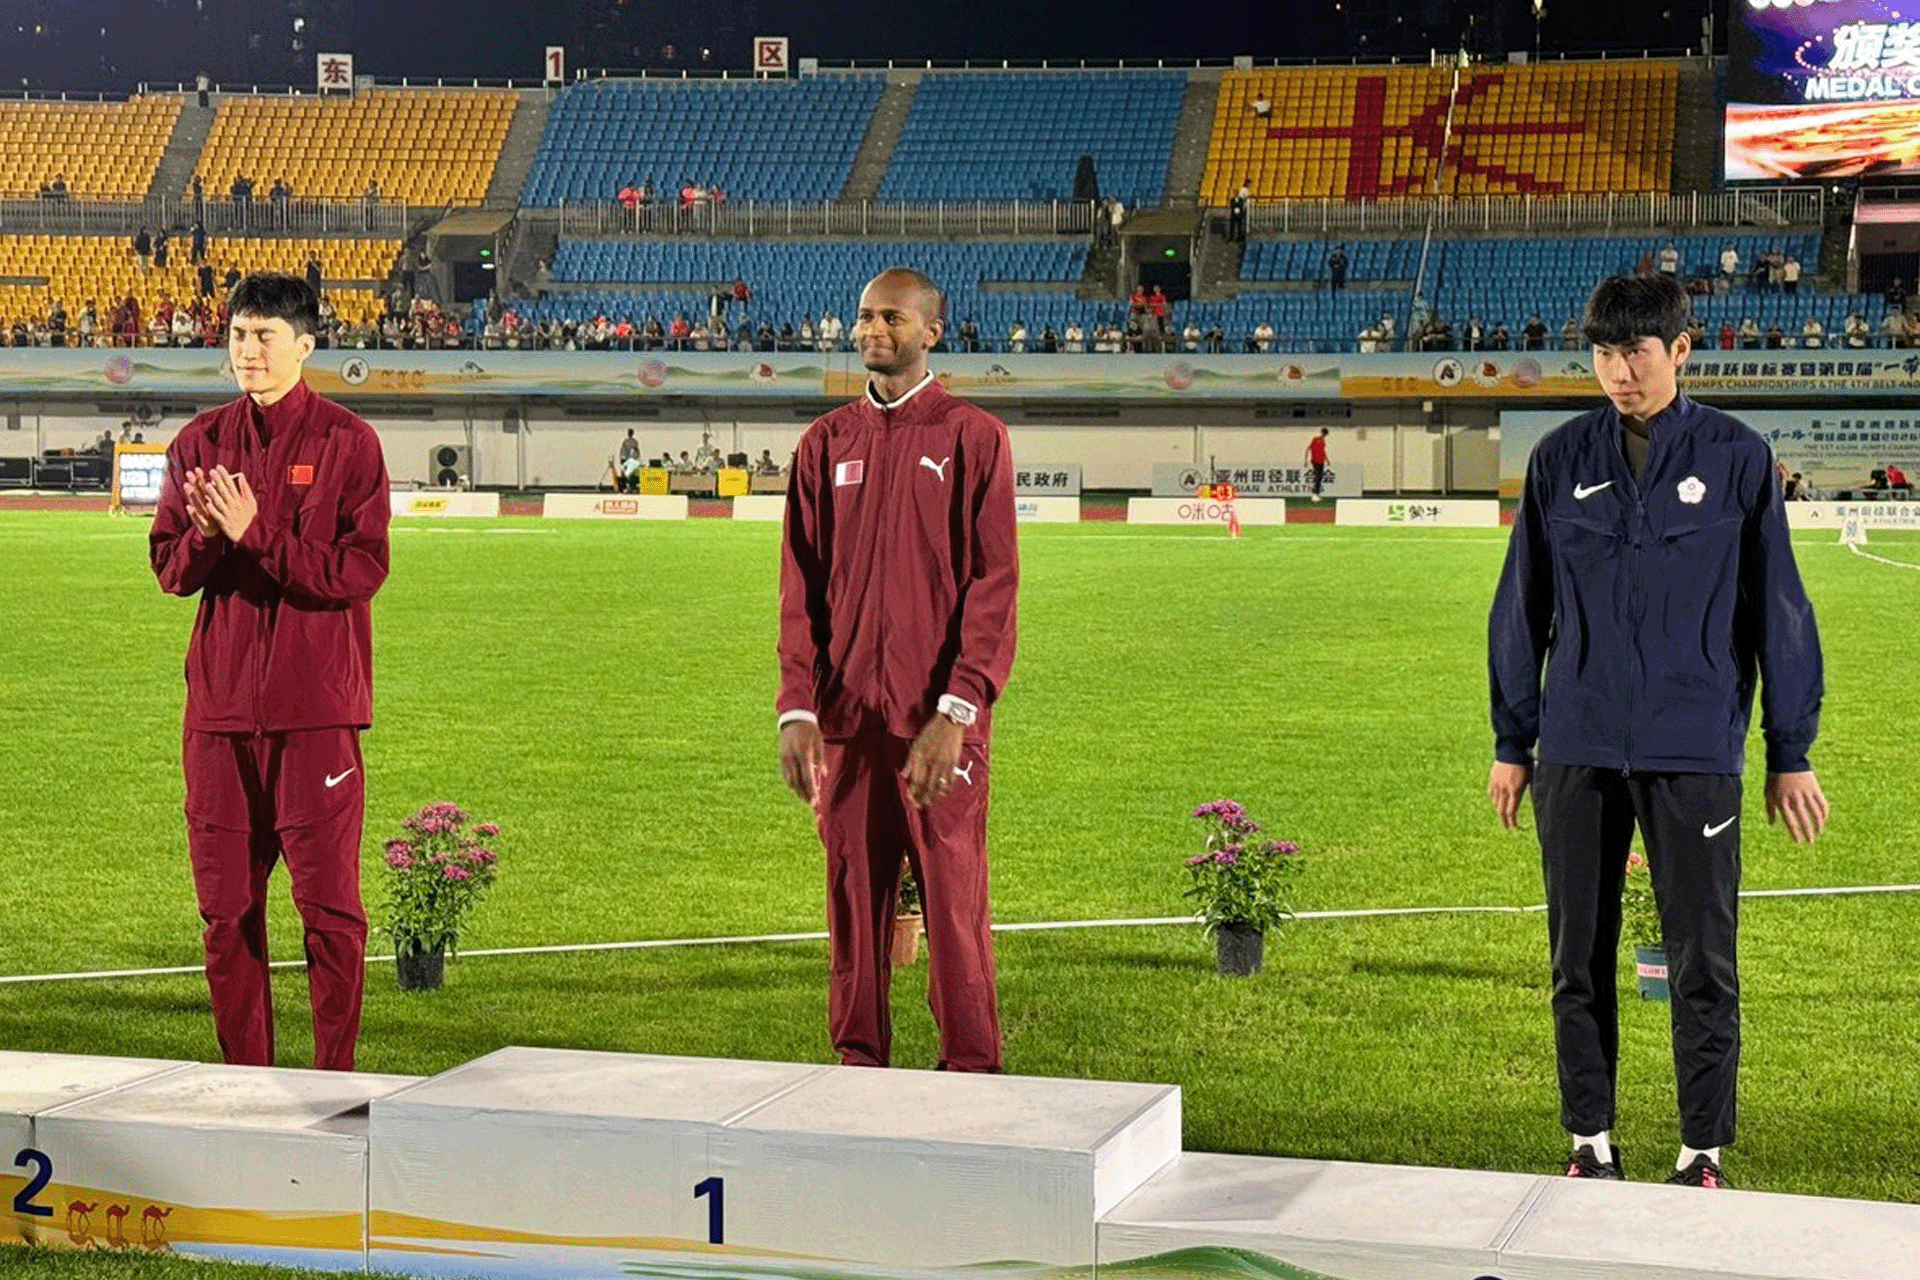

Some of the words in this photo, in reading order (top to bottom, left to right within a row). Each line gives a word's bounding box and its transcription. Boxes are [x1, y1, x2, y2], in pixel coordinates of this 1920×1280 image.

[321, 58, 349, 84] 东
[549, 52, 559, 78] 1
[759, 41, 783, 67] 区
[1804, 77, 1901, 100] MEDAL
[1016, 472, 1068, 487] 民政府
[14, 1148, 53, 1216] 2
[694, 1177, 723, 1244] 1
